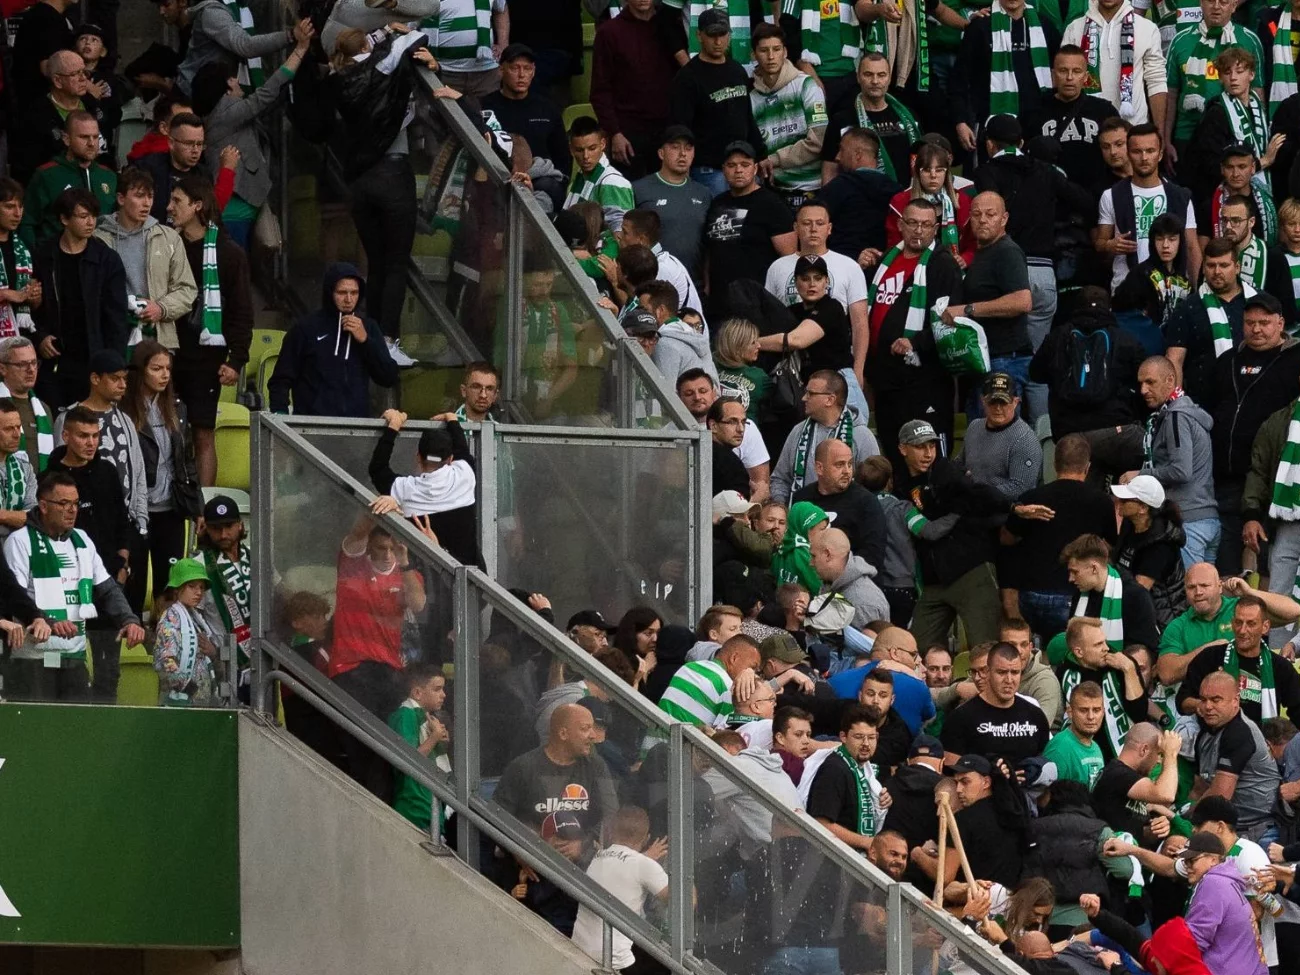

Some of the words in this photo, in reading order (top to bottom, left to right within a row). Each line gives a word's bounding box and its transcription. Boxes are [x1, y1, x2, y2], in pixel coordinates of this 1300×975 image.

[771, 121, 799, 136] Energa
[1041, 117, 1099, 144] GAP
[535, 798, 590, 813] ellesse
